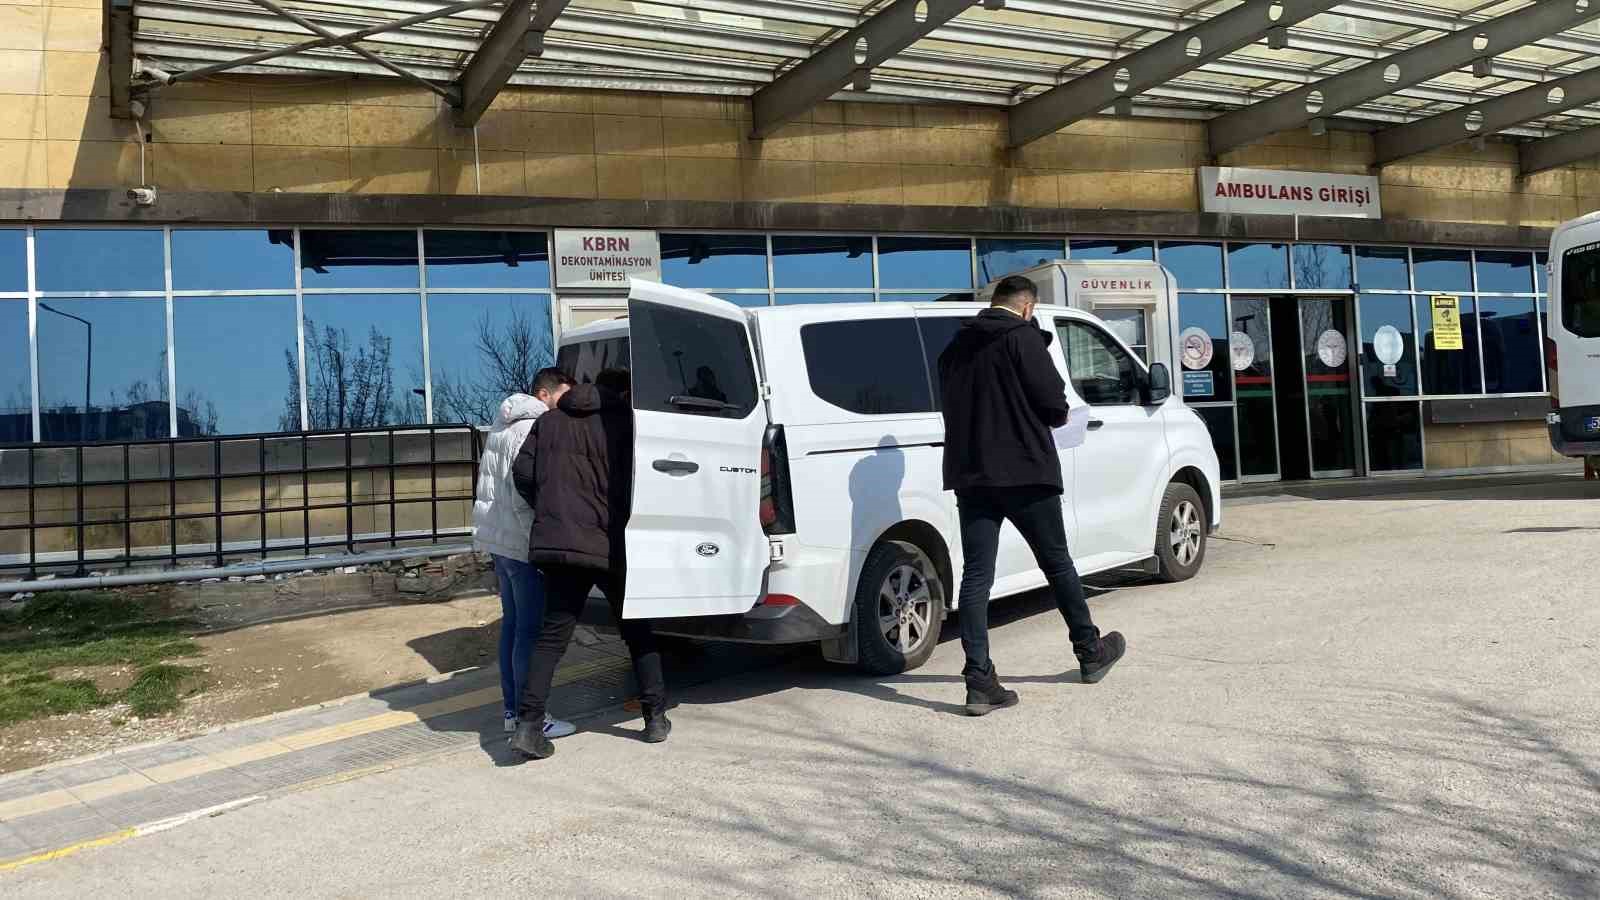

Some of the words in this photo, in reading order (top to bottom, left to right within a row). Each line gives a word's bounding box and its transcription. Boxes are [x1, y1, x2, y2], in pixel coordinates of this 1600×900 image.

[1215, 182, 1313, 201] AMBULANS
[1319, 184, 1371, 207] GİRİŞİ
[583, 236, 630, 252] KBRN
[561, 255, 652, 267] DEKONTAMİNASYON
[589, 270, 626, 281] ÜNİTESİ
[1081, 279, 1152, 289] GÜVENLİK
[719, 466, 757, 474] CUSTOM
